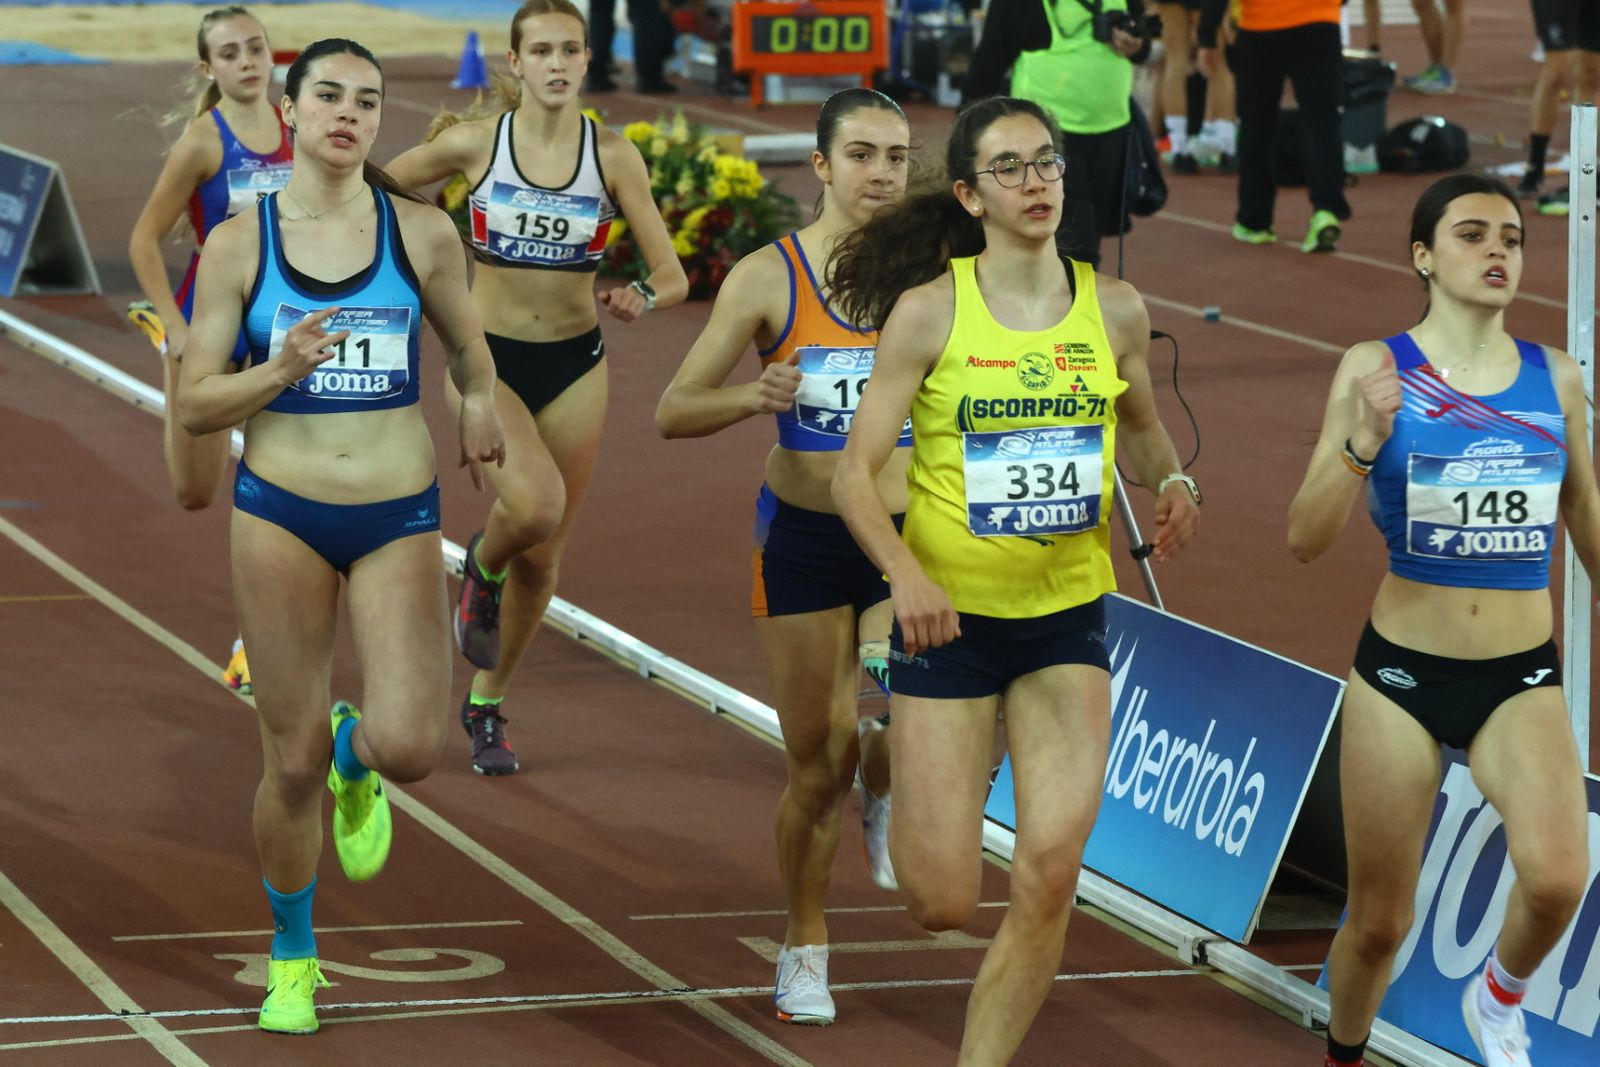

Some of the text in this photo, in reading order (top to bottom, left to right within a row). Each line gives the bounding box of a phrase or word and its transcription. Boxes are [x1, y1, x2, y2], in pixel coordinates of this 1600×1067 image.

[515, 212, 570, 242] 159
[966, 355, 1016, 369] Alcampo
[972, 397, 1107, 418] SCORPIO-71
[1006, 461, 1080, 500] 334
[1453, 490, 1528, 525] 148
[1105, 686, 1264, 857] Iberdrola
